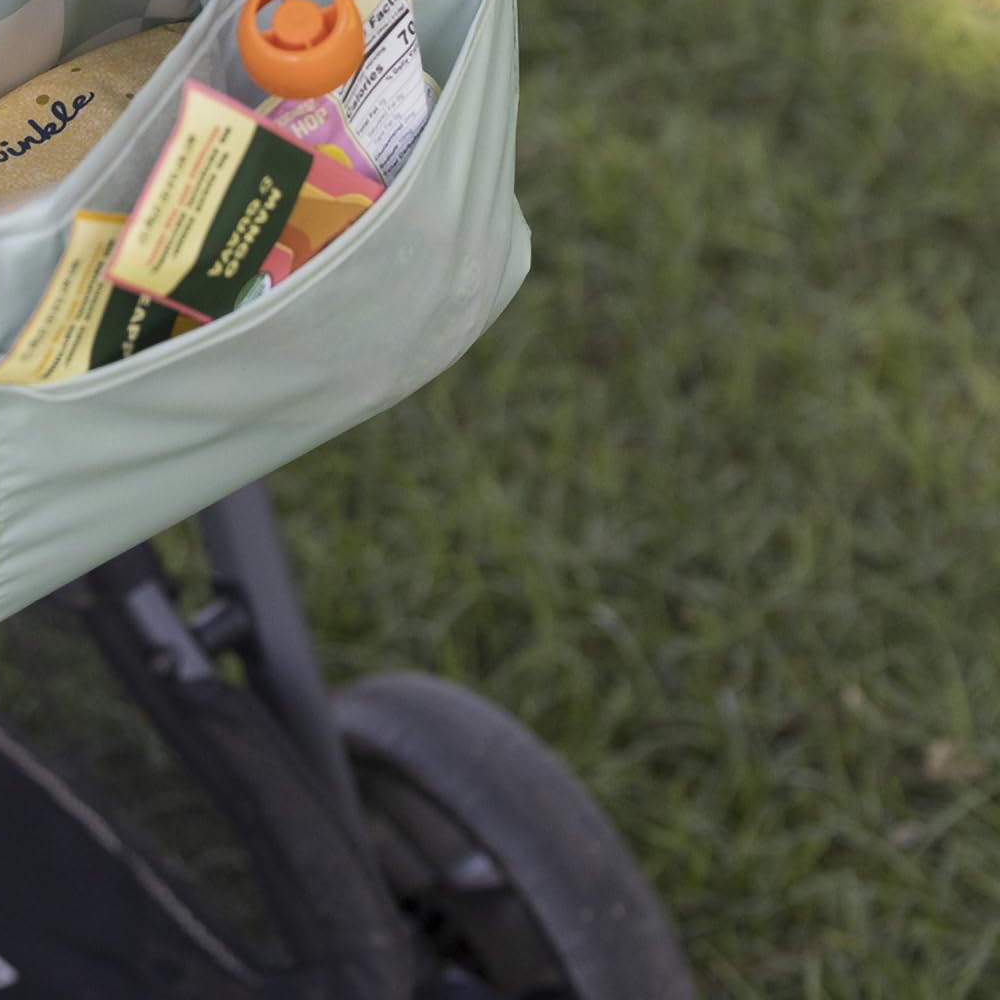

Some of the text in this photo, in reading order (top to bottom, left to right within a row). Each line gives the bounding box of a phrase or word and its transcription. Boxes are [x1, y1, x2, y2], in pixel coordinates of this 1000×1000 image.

[347, 64, 384, 119] Calories
[207, 198, 261, 278] GUAVA
[223, 186, 283, 278] MANGO
